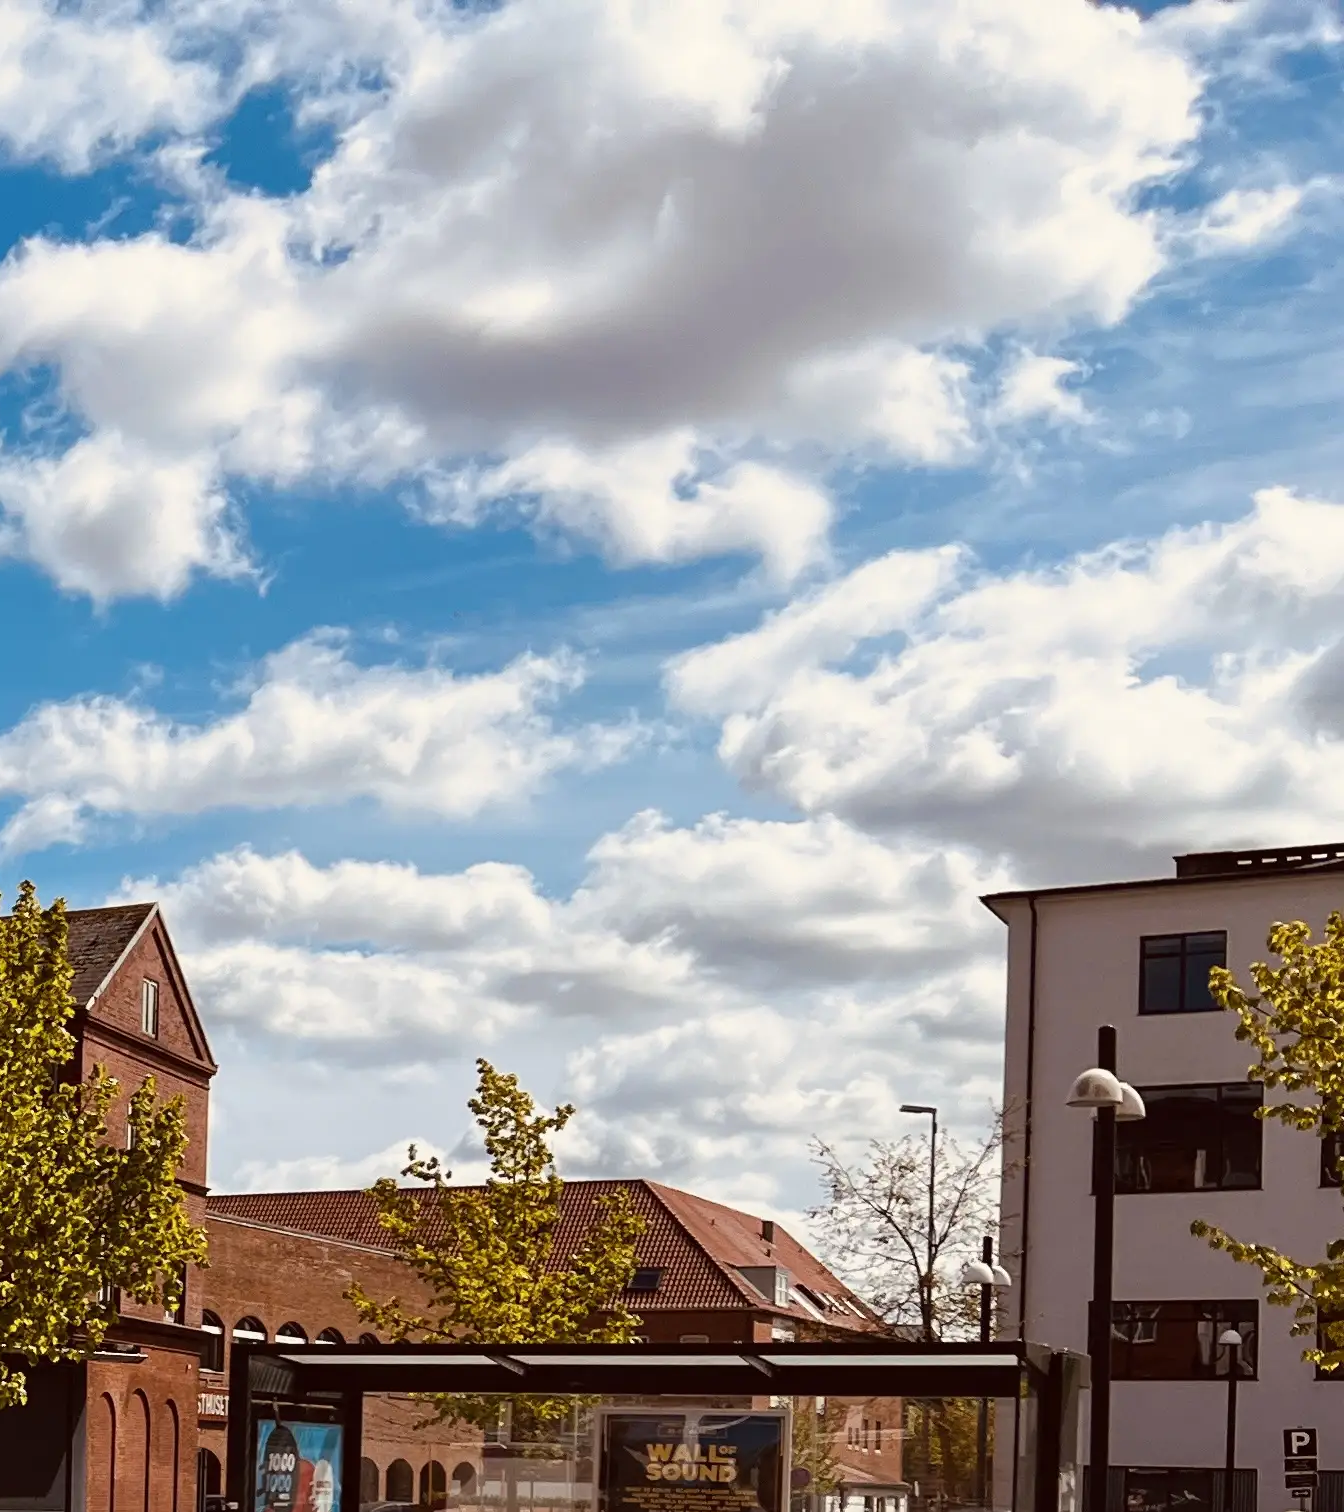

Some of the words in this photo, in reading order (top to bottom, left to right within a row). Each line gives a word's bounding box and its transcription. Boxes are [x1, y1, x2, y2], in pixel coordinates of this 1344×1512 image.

[1291, 1431, 1310, 1454] P
[268, 1453, 296, 1472] 1000
[646, 1443, 735, 1464] WALL
[719, 1445, 738, 1455] OF
[266, 1474, 292, 1492] 1000
[646, 1463, 737, 1483] SOUND
